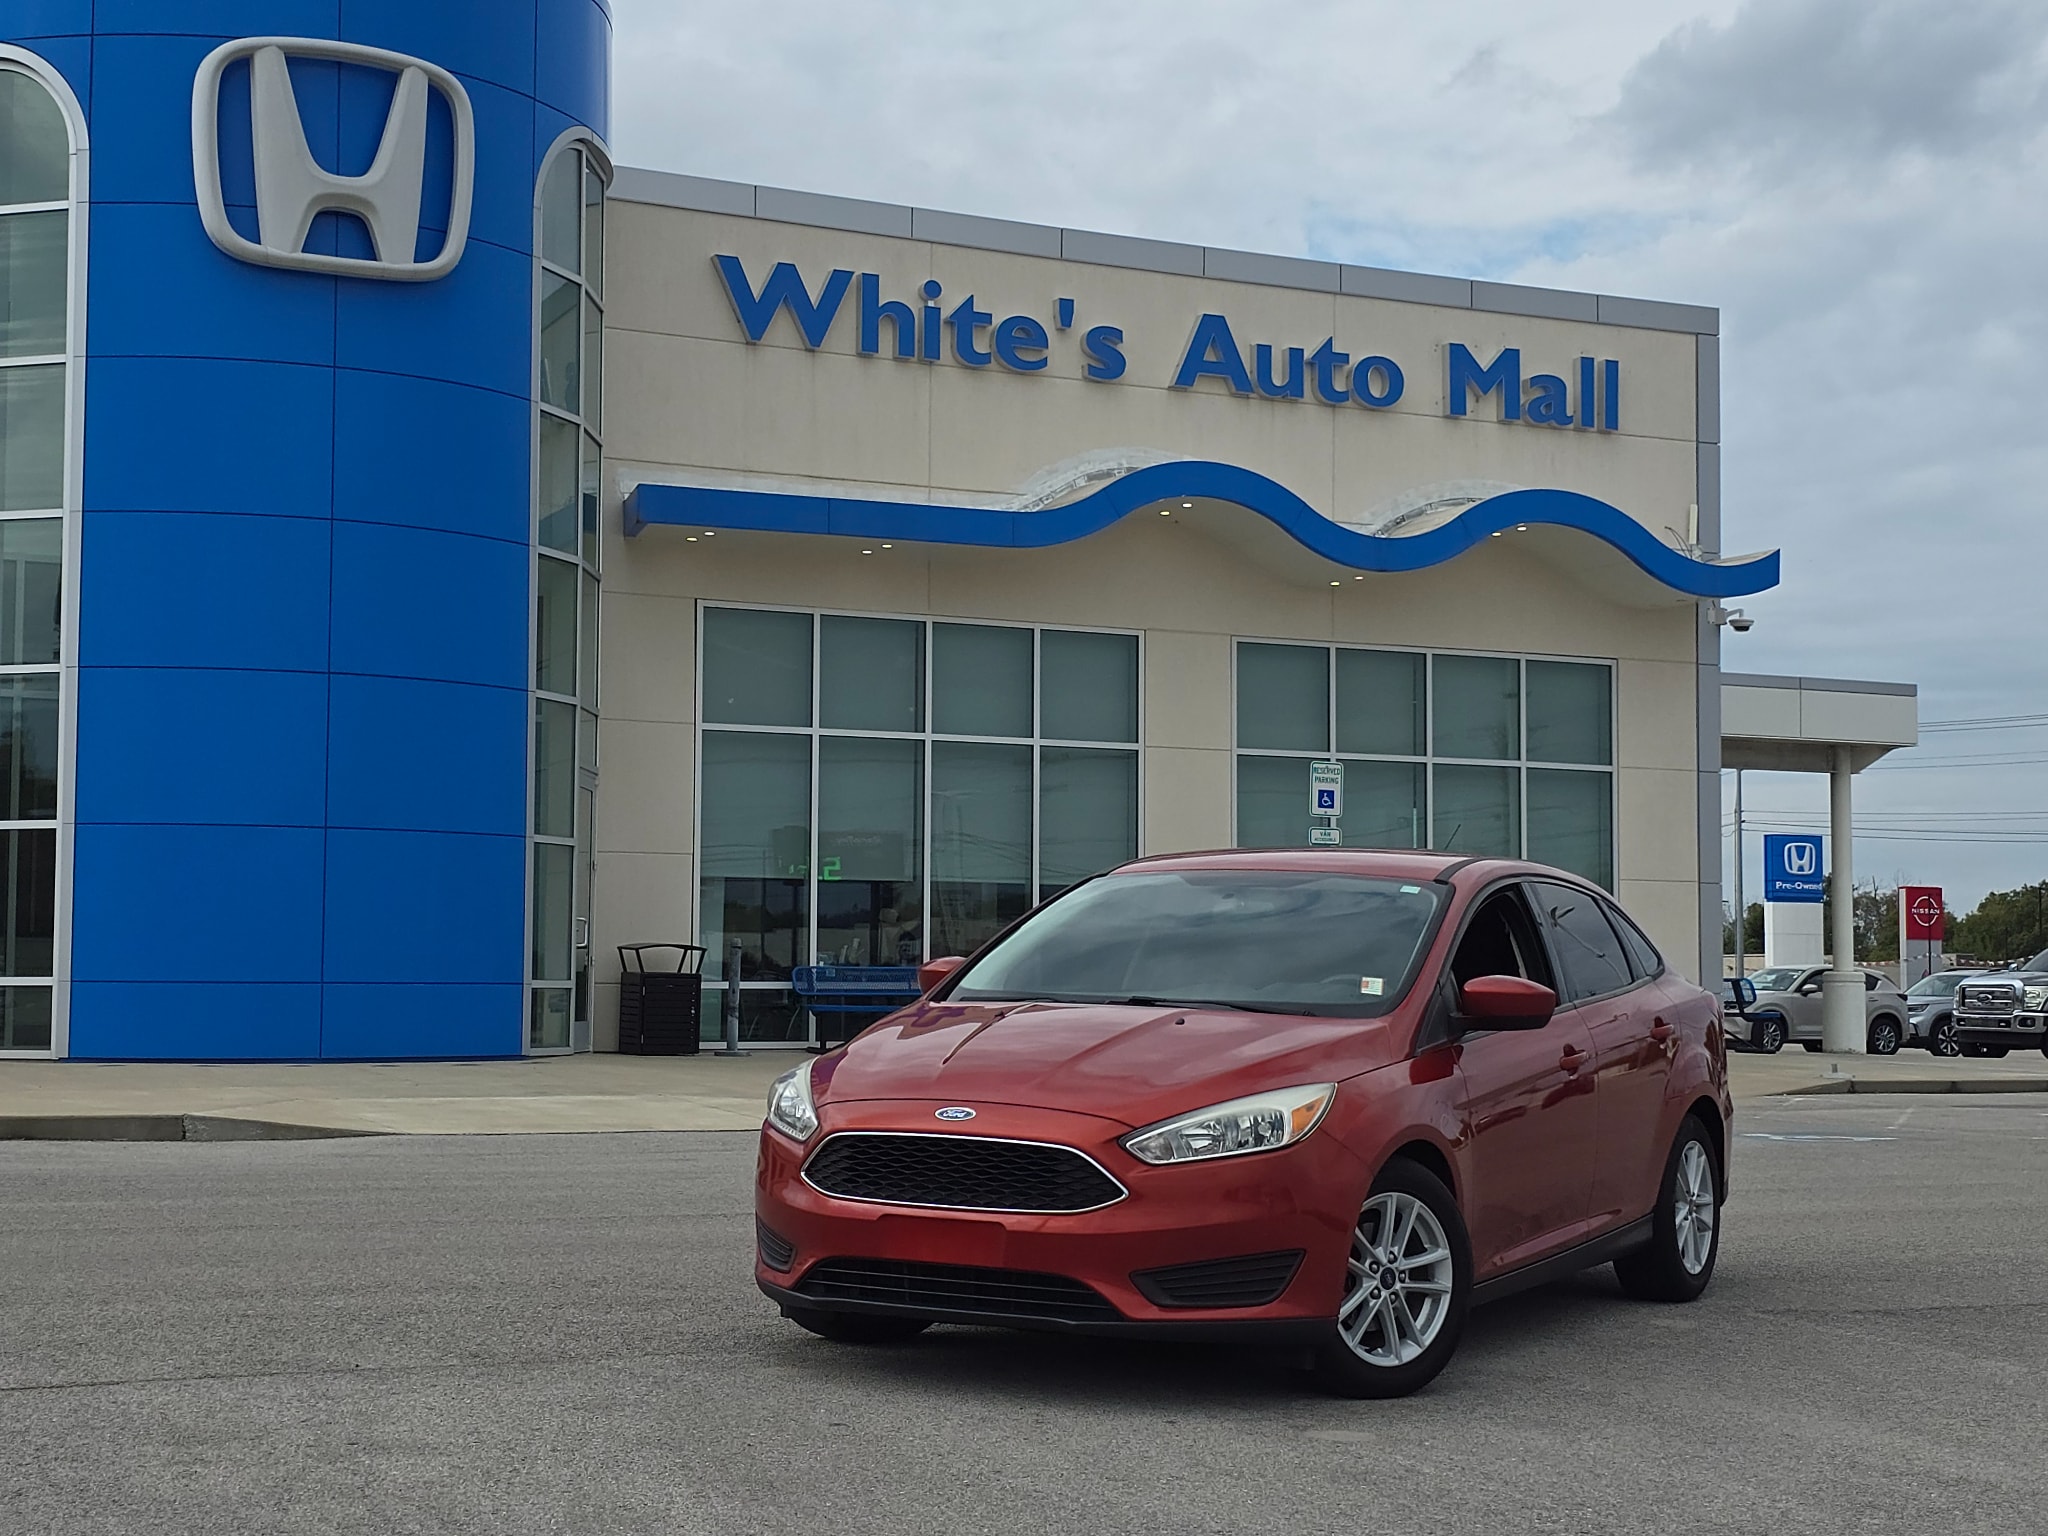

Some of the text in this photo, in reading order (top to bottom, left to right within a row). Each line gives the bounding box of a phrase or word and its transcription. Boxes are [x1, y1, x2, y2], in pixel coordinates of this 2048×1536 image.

[711, 254, 1619, 431] White's Auto Mall
[1314, 776, 1339, 784] PARKING
